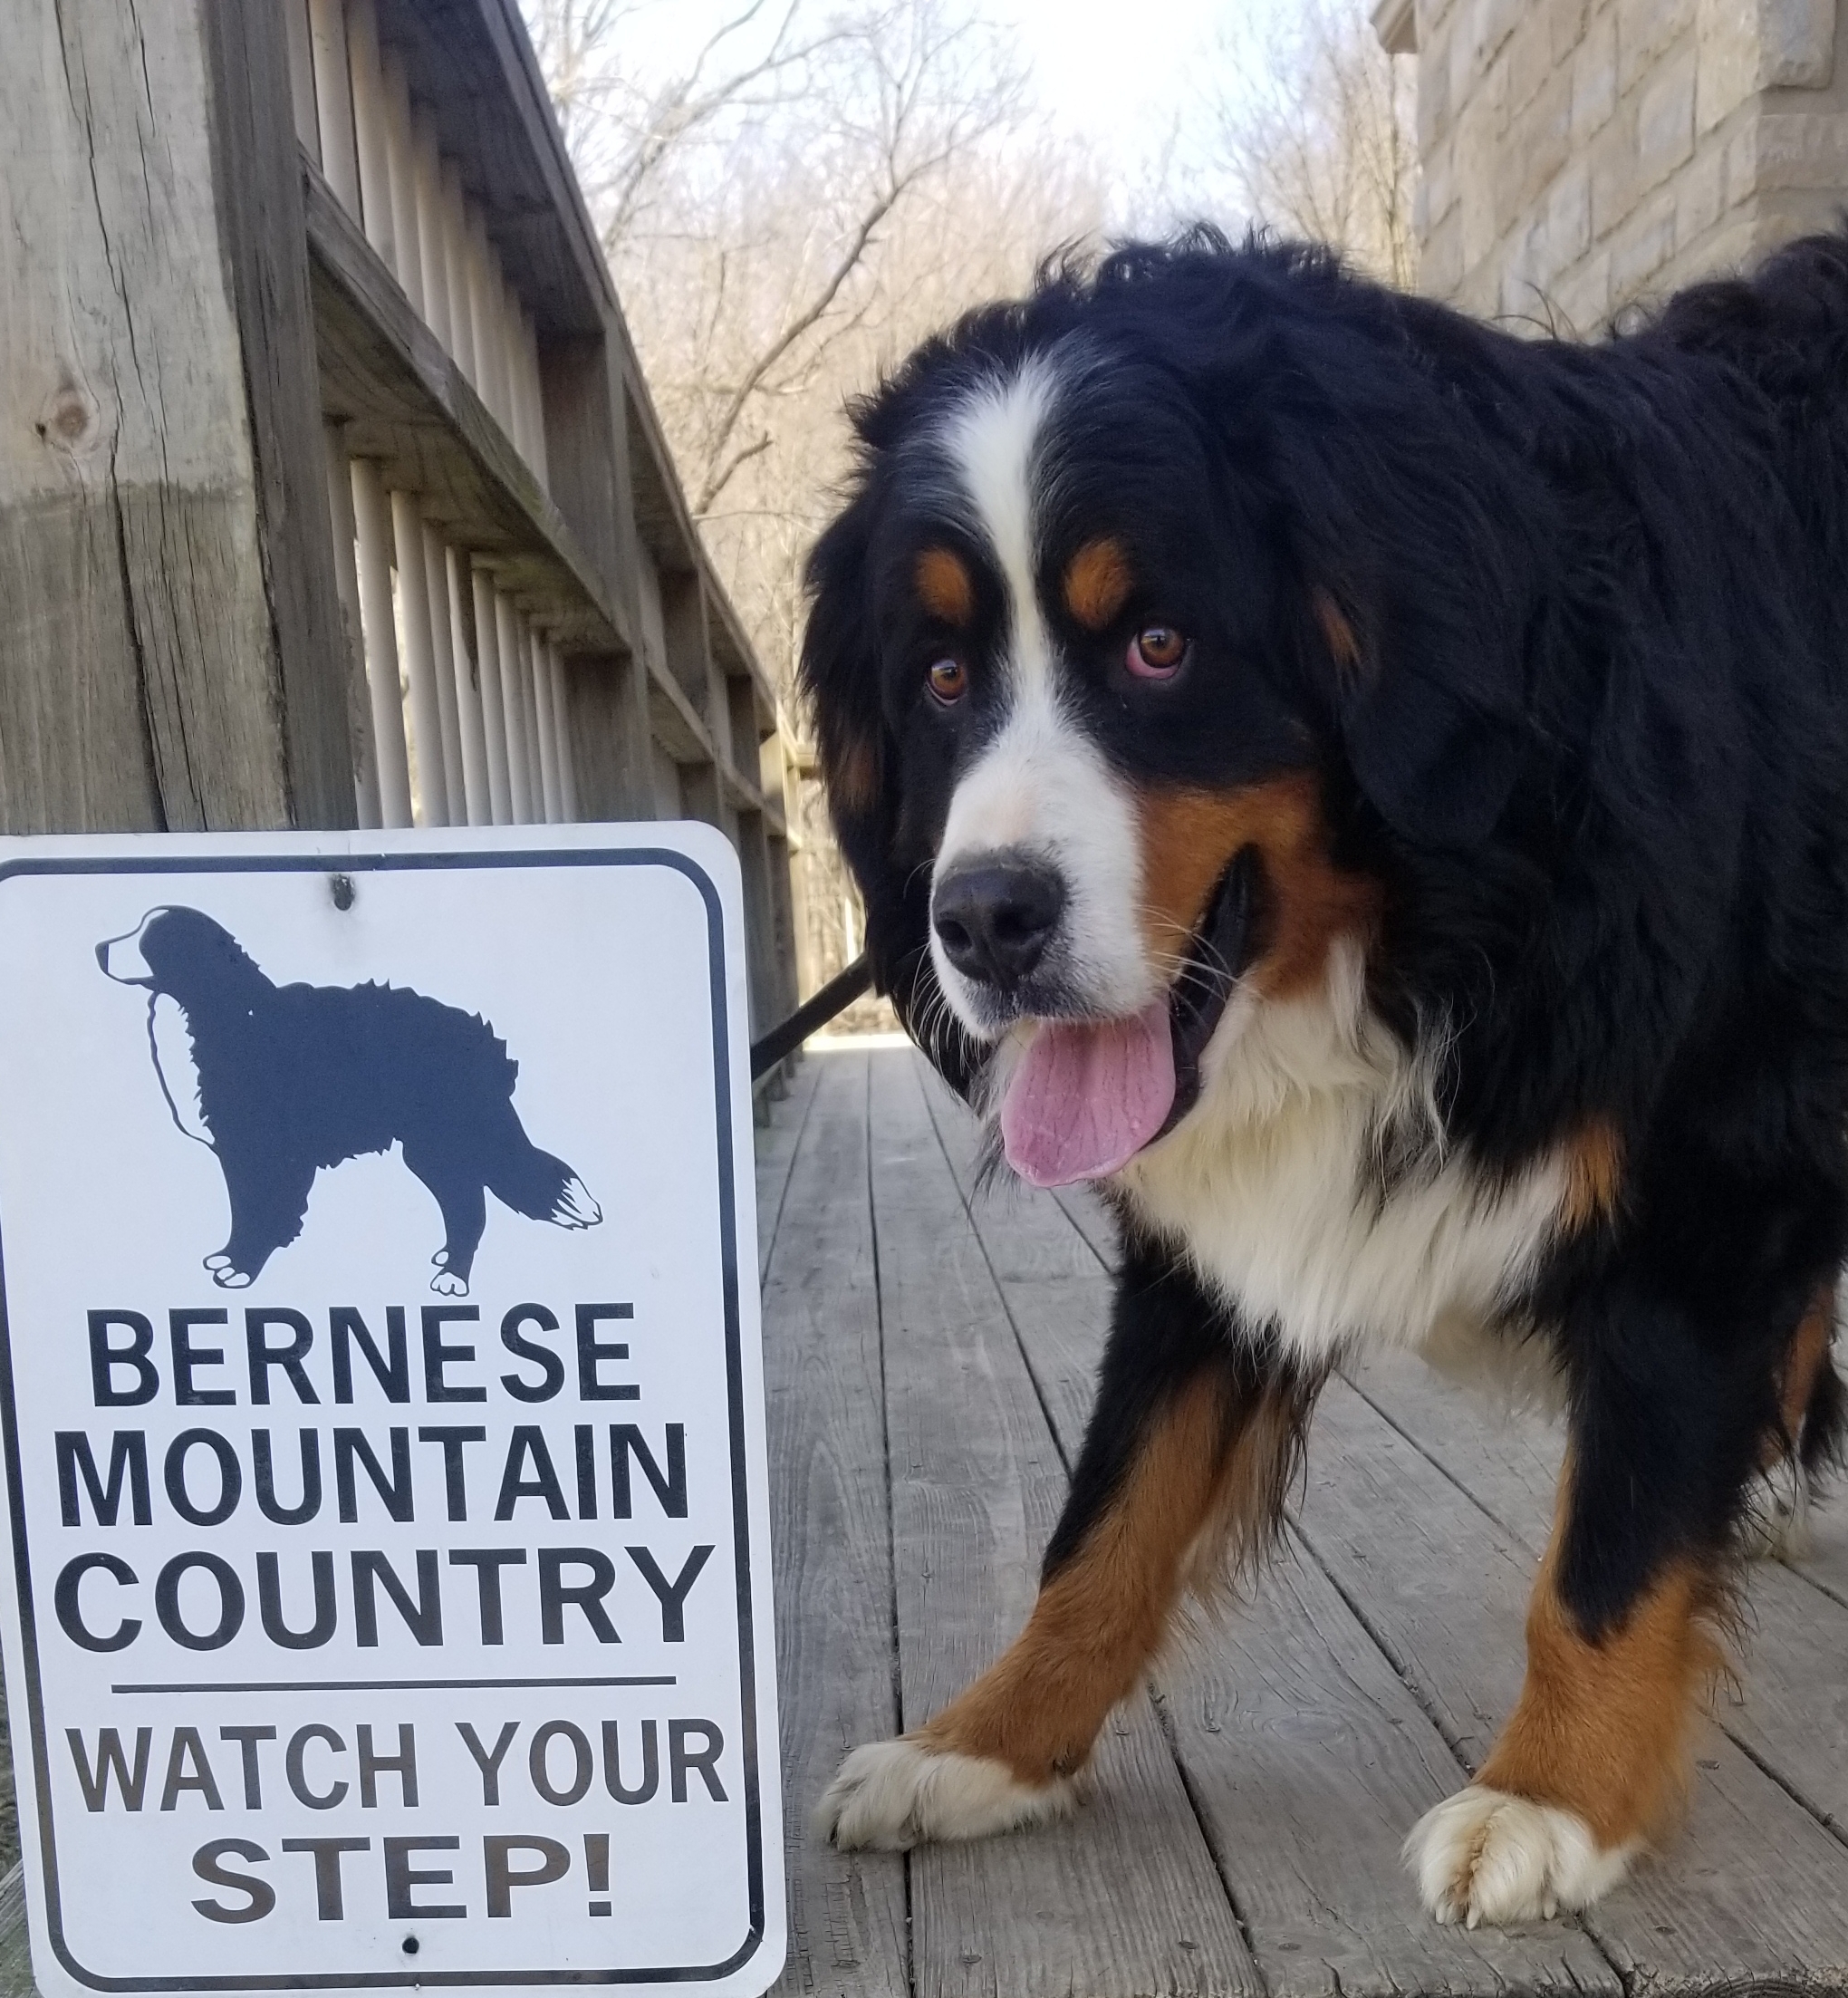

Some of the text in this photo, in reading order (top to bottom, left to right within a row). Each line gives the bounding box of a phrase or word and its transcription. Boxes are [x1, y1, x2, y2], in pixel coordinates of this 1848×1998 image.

[87, 1302, 640, 1407] BERNESE
[55, 1423, 688, 1527] MOUNTAIN
[54, 1544, 717, 1653] COUNTRY
[65, 1718, 729, 1812] WATCH YOUR
[191, 1833, 613, 1925] STEP!
